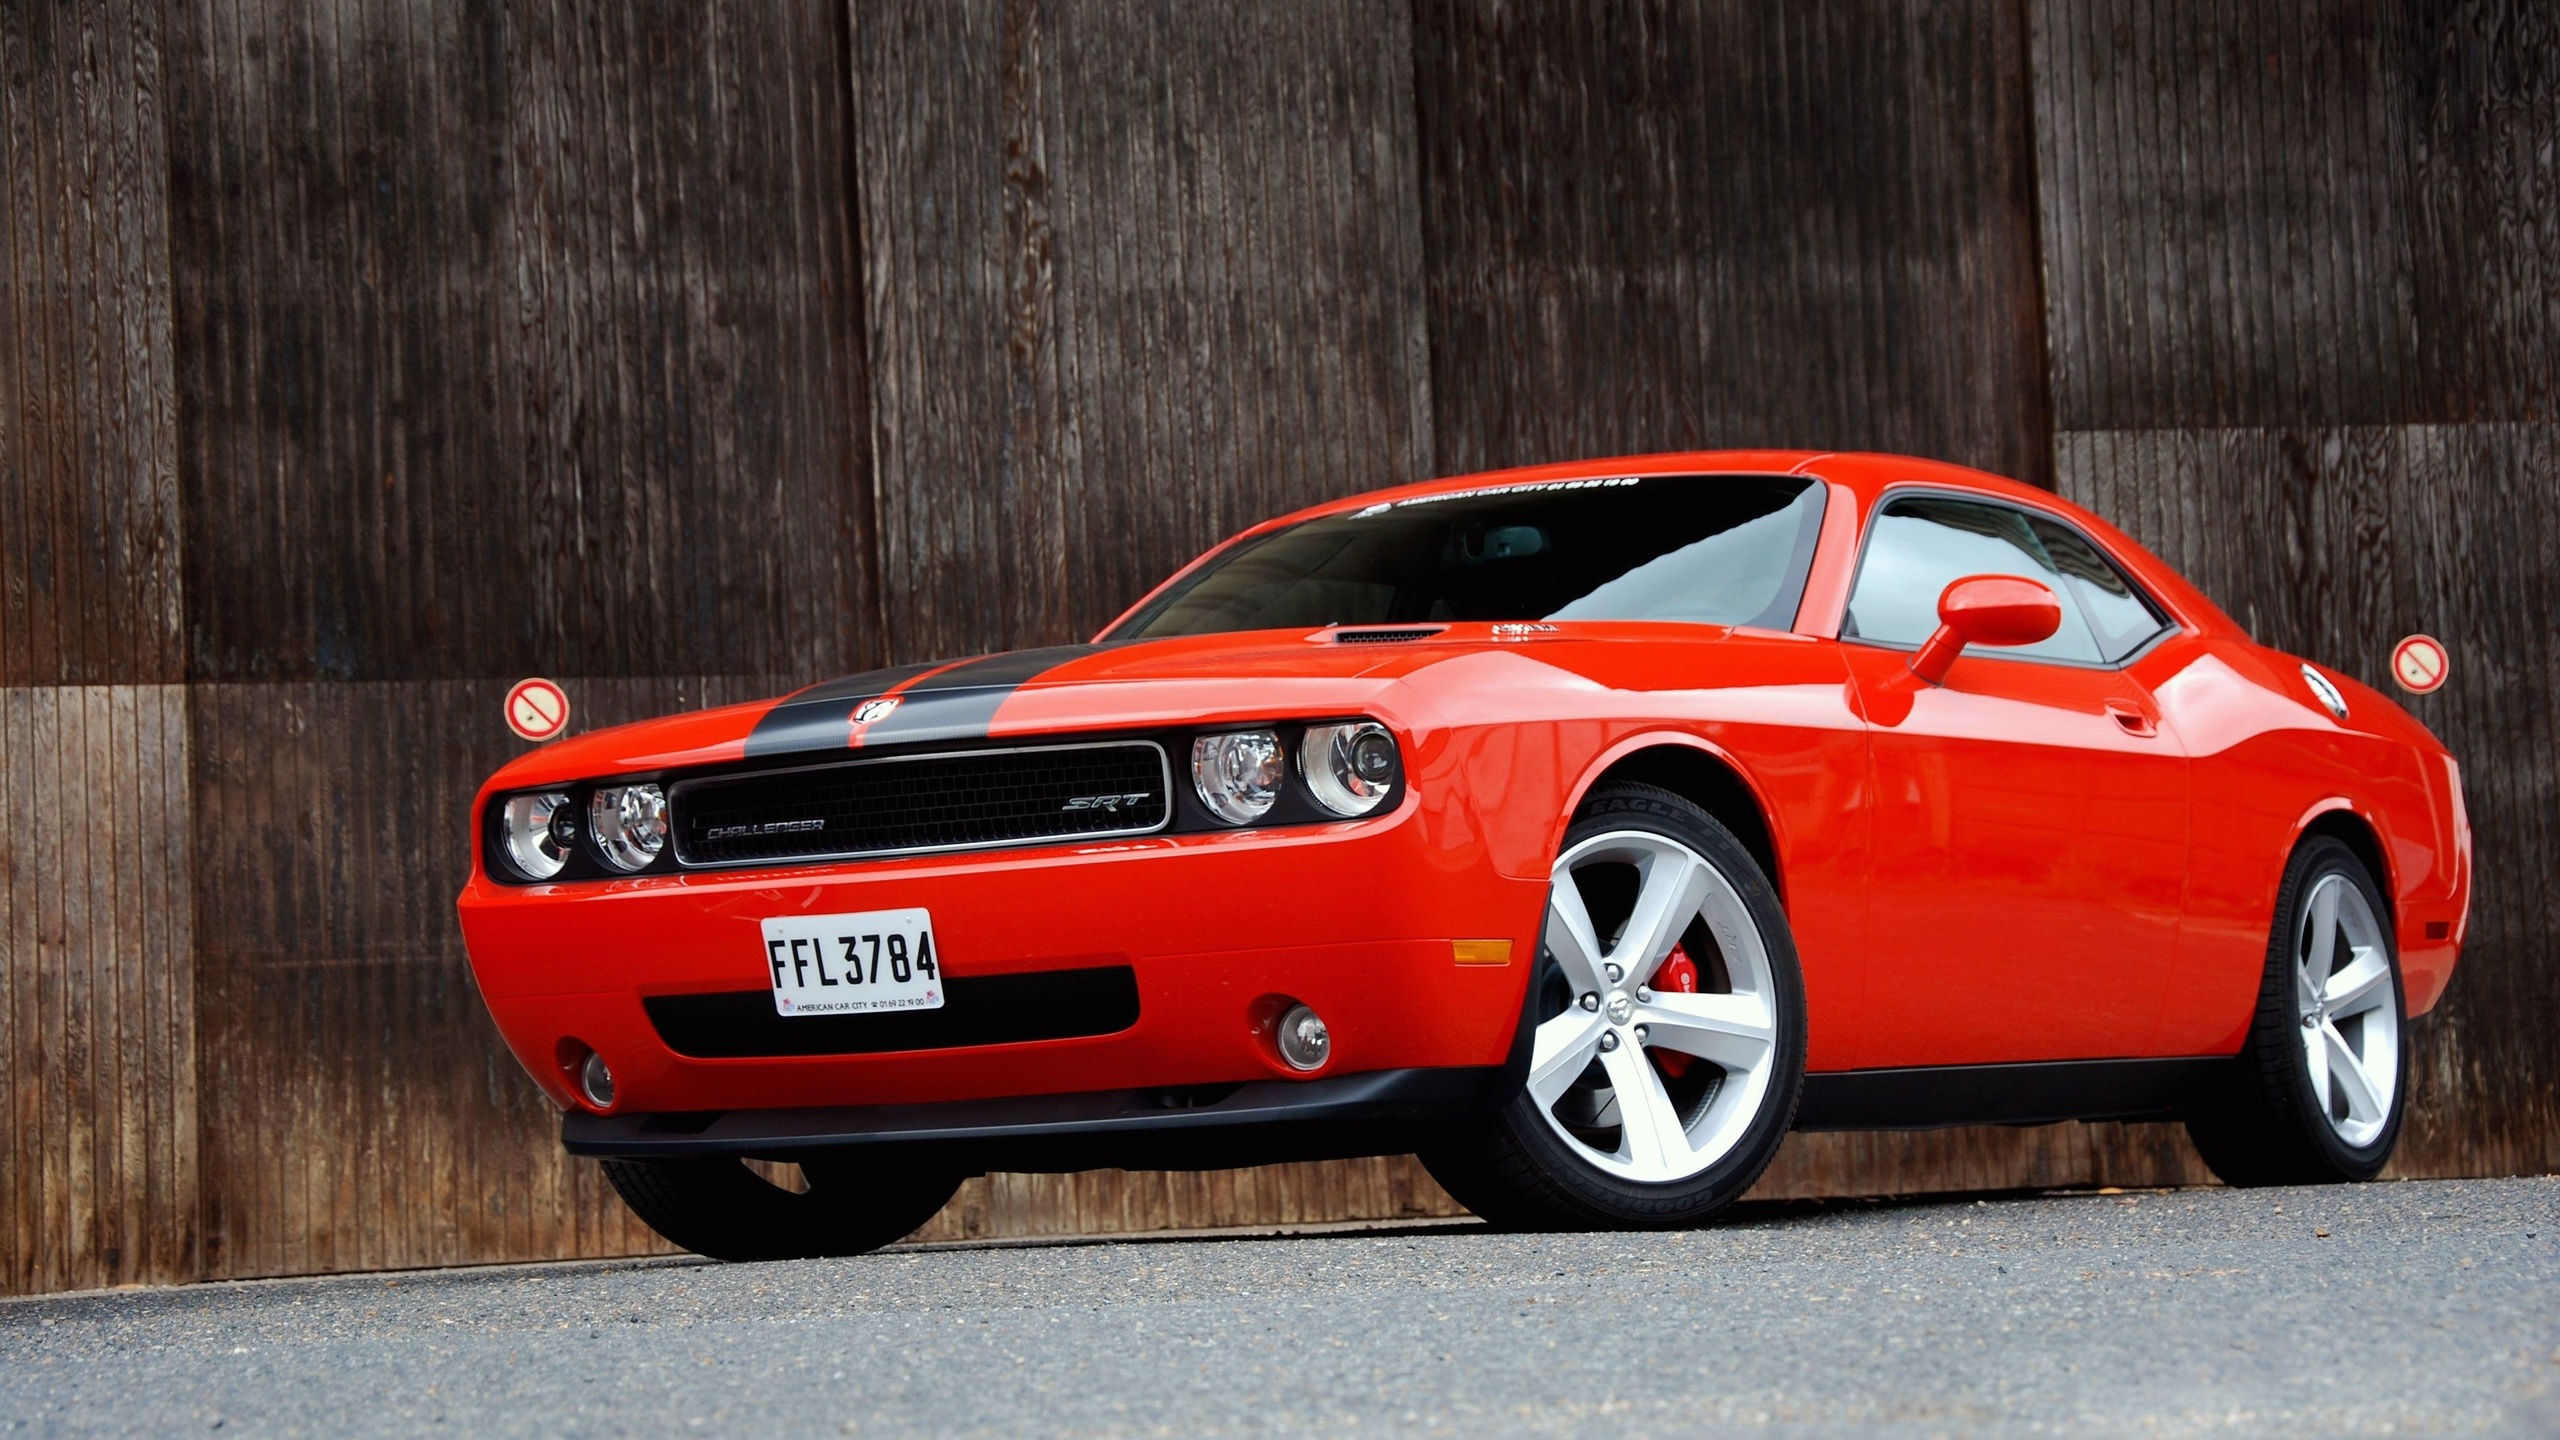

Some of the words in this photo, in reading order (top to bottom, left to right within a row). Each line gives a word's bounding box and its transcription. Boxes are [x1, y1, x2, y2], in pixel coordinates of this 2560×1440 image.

[1397, 490, 1476, 506] AMERICAN
[1477, 487, 1510, 496] CAR
[1511, 484, 1547, 493] CITY
[1062, 793, 1150, 812] SRT
[707, 819, 825, 839] CHALLENGER
[1589, 798, 1686, 822] EAGLE
[1702, 827, 1733, 851] F1
[768, 931, 936, 989] FFL3784
[797, 1003, 834, 1012] AMERICAN
[835, 1002, 850, 1011] CAR
[852, 1001, 868, 1010] CITY
[898, 999, 906, 1007] 22
[915, 998, 925, 1006] 00
